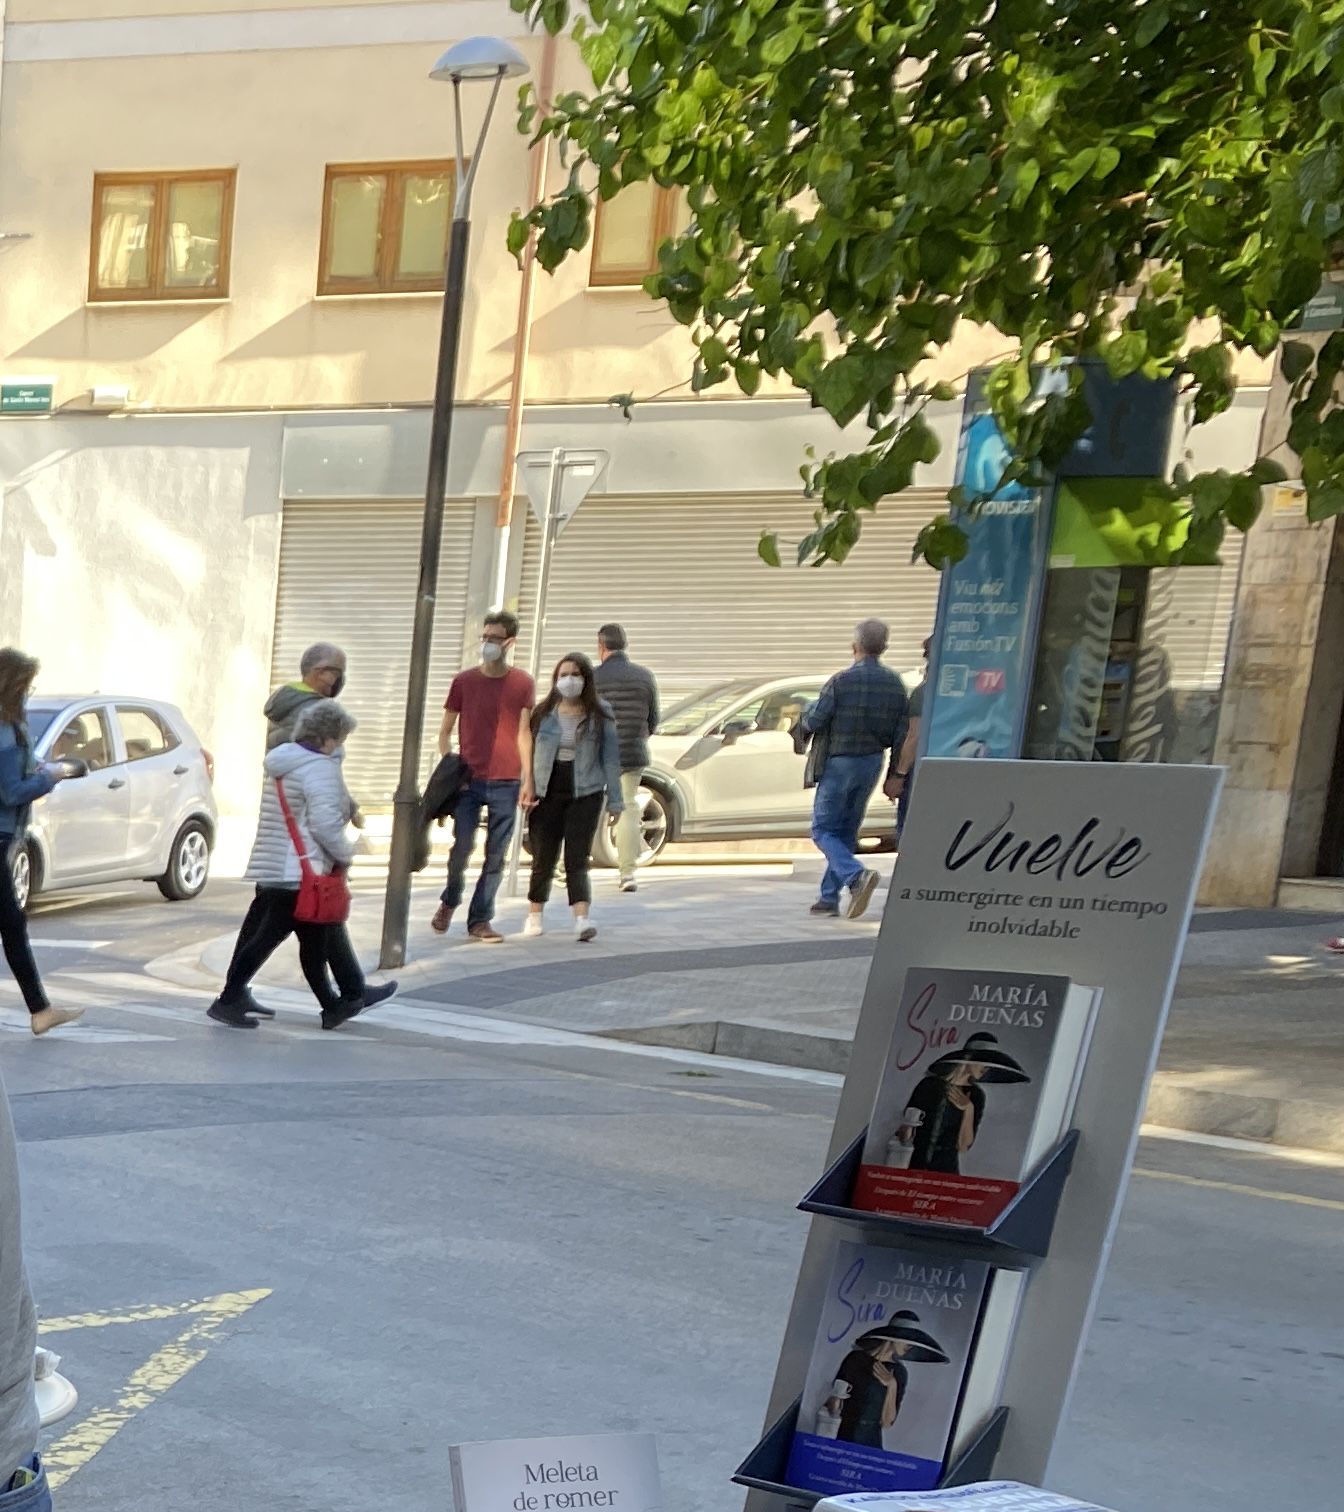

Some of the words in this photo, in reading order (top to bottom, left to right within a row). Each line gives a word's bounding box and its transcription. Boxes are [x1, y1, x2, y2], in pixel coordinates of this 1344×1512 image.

[944, 802, 1151, 882] Vuelve
[900, 889, 912, 902] a
[915, 887, 1024, 911] sumergirte
[1029, 894, 1053, 909] en
[1059, 895, 1086, 910] un
[1091, 895, 1168, 919] tiempo
[967, 916, 1082, 940] inolvidable
[968, 983, 1050, 1009] MARÍA
[896, 982, 959, 1072] Sira
[948, 1001, 1046, 1029] DUEÑAS
[896, 1261, 968, 1291] MARÍA
[827, 1257, 887, 1344] Sira
[875, 1279, 964, 1312] DUEÑAS
[524, 1460, 600, 1485] Meleta
[513, 1491, 539, 1512] de
[539, 1489, 620, 1511] romer
